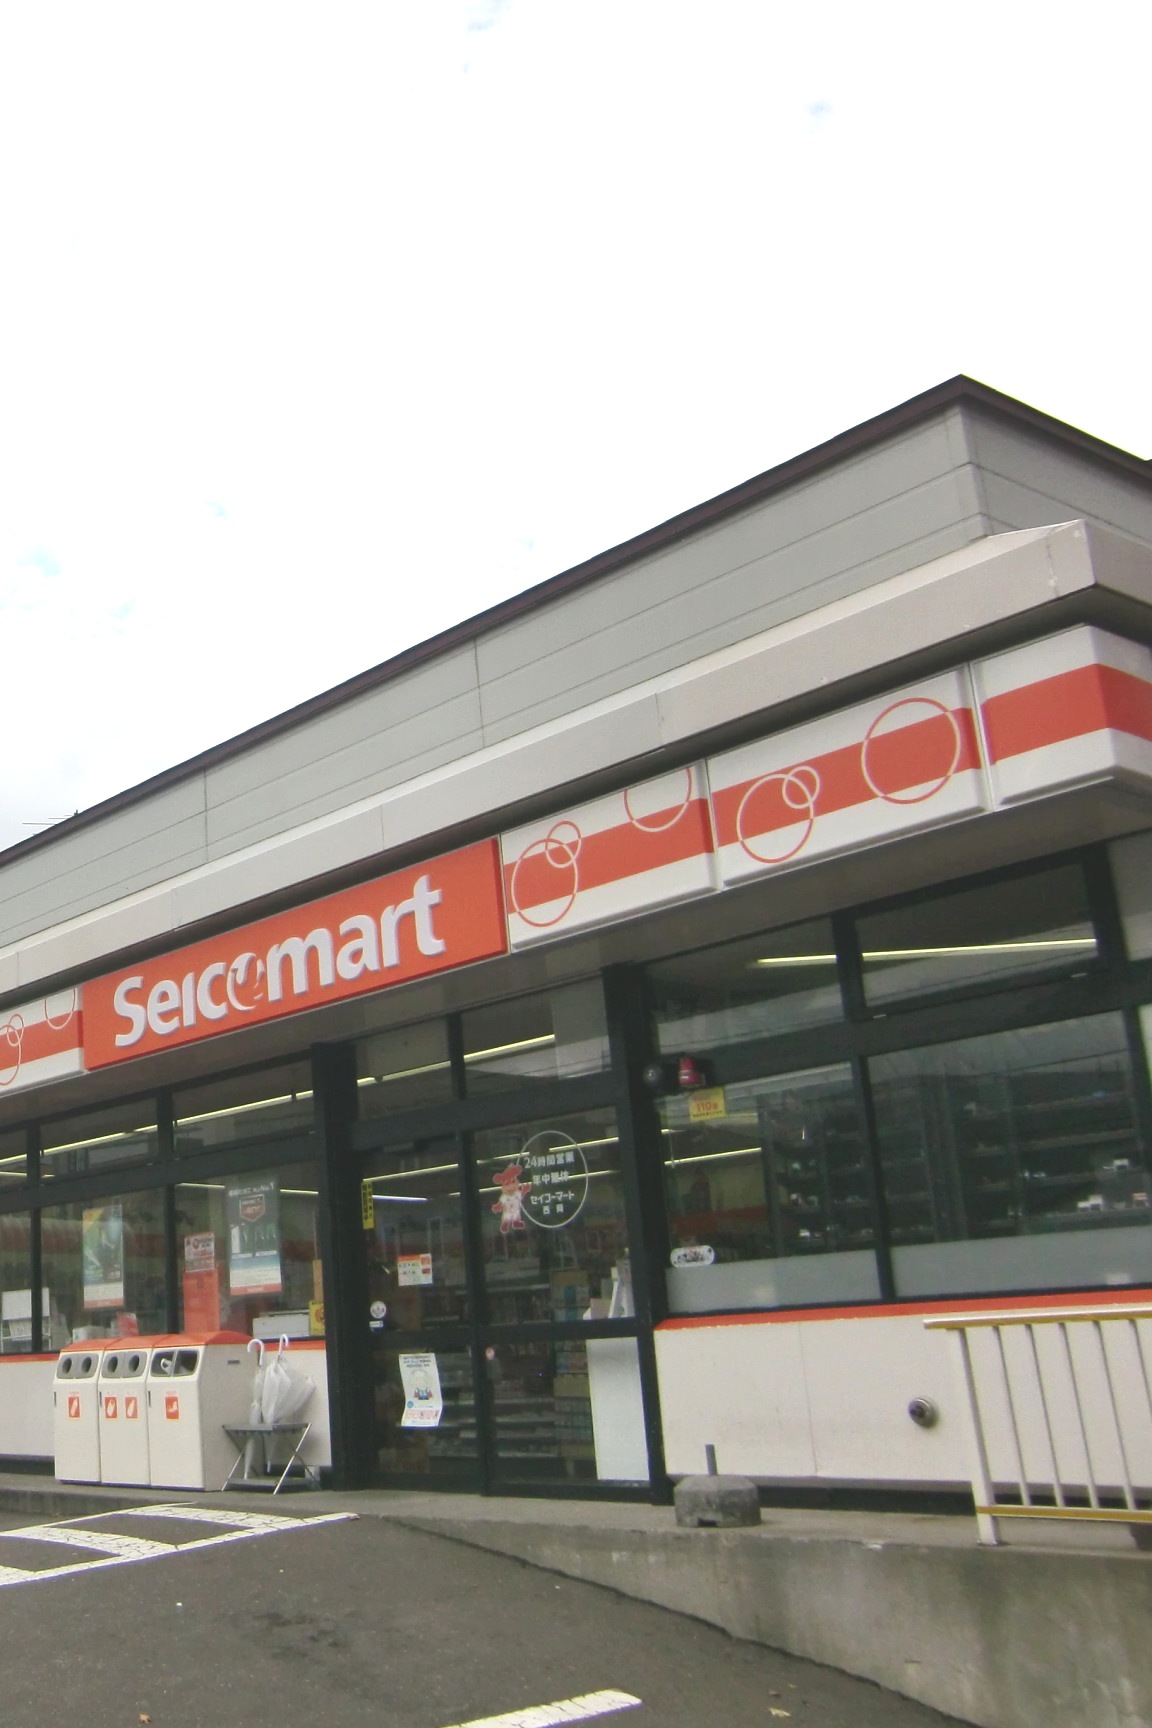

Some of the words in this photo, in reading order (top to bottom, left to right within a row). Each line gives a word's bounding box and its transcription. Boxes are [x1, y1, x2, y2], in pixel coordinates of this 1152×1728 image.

[113, 874, 446, 1048] Seicomart
[530, 1190, 575, 1205] セイコーマート
